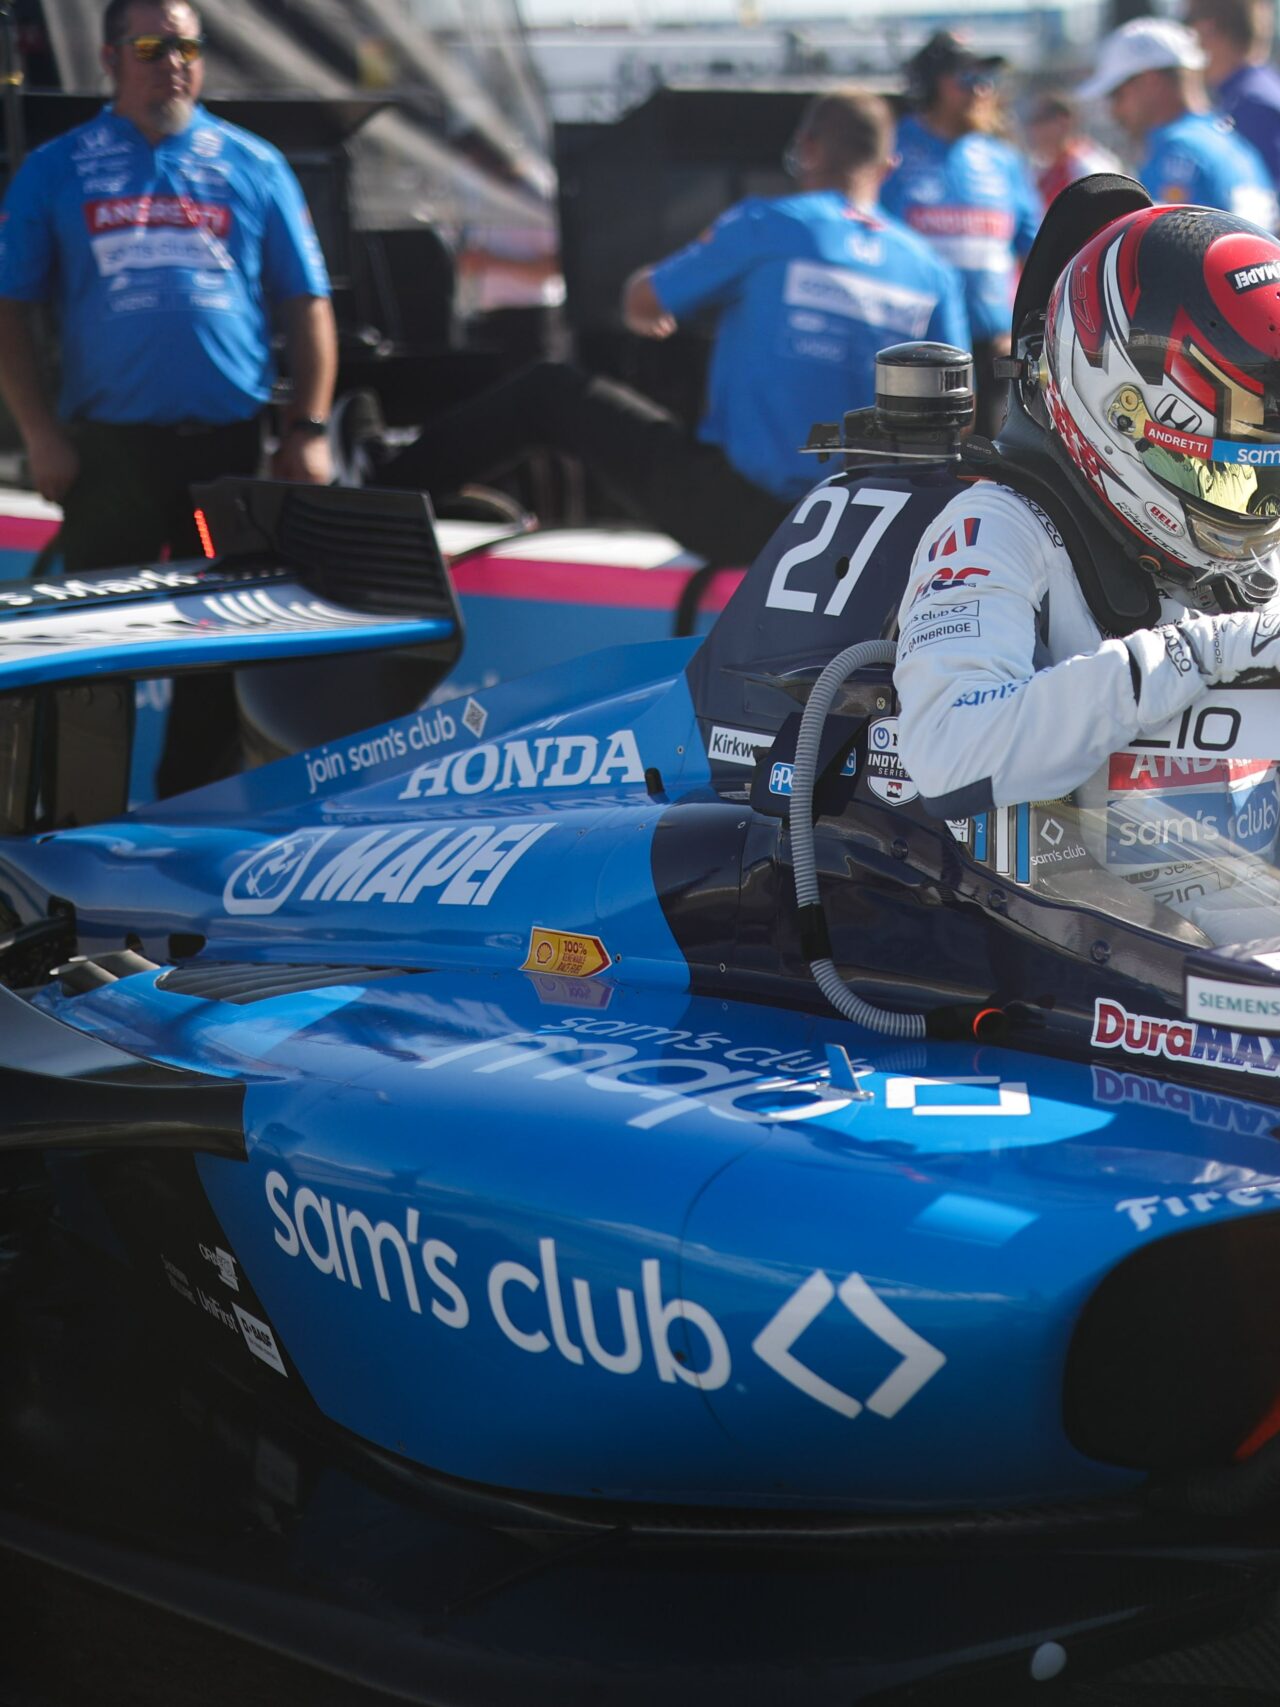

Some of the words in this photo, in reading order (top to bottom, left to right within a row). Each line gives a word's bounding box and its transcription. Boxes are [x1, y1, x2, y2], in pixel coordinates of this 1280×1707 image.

[1148, 428, 1208, 453] ANDRETTI
[1150, 506, 1179, 532] BELL
[766, 487, 911, 616] 27
[908, 622, 972, 654] GAINBRIDGE
[713, 733, 757, 757] Kirkw
[1128, 705, 1242, 752] IO
[304, 743, 346, 794] join
[352, 728, 406, 771] sam's
[409, 709, 456, 750] club
[399, 729, 646, 799] HONDA
[1118, 810, 1220, 846] sam's
[301, 823, 558, 906] MAPEI
[1030, 850, 1063, 866] sam's
[1063, 845, 1086, 860] club
[563, 940, 588, 955] 100%
[538, 1016, 734, 1052] sam's
[265, 1170, 469, 1329] sam's
[488, 1237, 731, 1390] club
